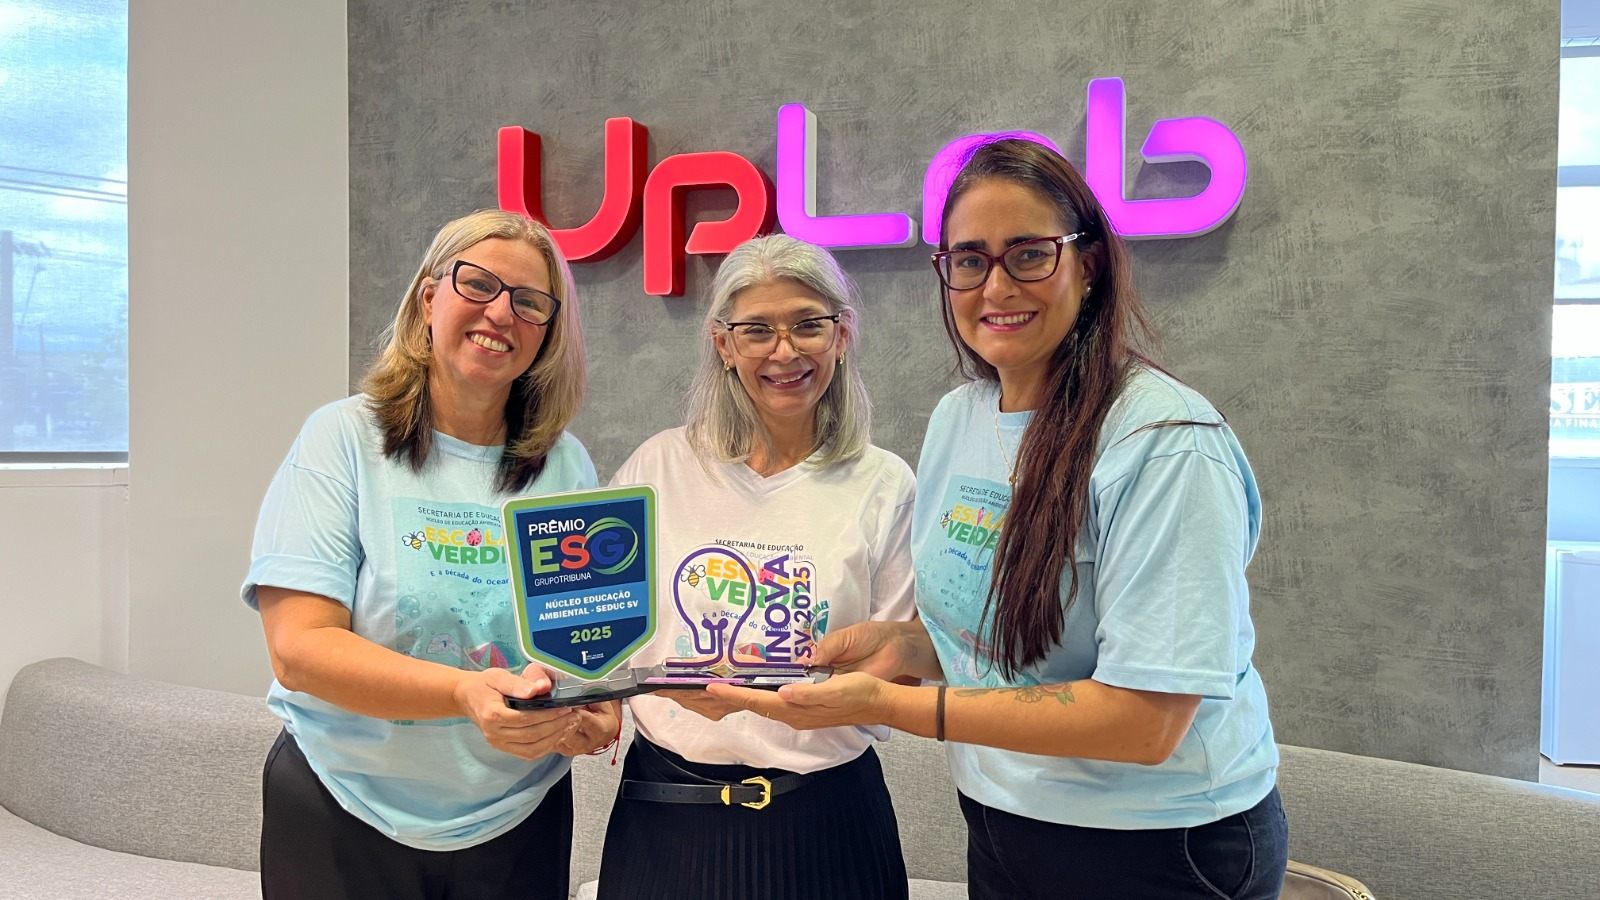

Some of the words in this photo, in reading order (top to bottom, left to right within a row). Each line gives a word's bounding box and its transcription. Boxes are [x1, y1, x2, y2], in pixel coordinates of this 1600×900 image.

[418, 507, 461, 519] SECRETARIA
[464, 511, 474, 519] DE
[528, 519, 586, 536] PRÊMIO
[530, 530, 625, 575] ESG
[715, 538, 756, 549] SECRETARIA
[757, 543, 766, 551] DE
[445, 569, 470, 580] Década
[472, 576, 482, 584] do
[534, 571, 592, 587] GRUPOTRIBUNA
[545, 596, 581, 609] NÚCLEO
[583, 590, 631, 604] EDUCAÇÃO
[793, 567, 811, 623] 2025
[538, 608, 590, 621] AMBIENTAL
[595, 602, 626, 613] SEDUC
[627, 600, 639, 609] SV
[764, 554, 791, 662] INOVA
[570, 625, 612, 644] 2025
[795, 630, 812, 659] SV
